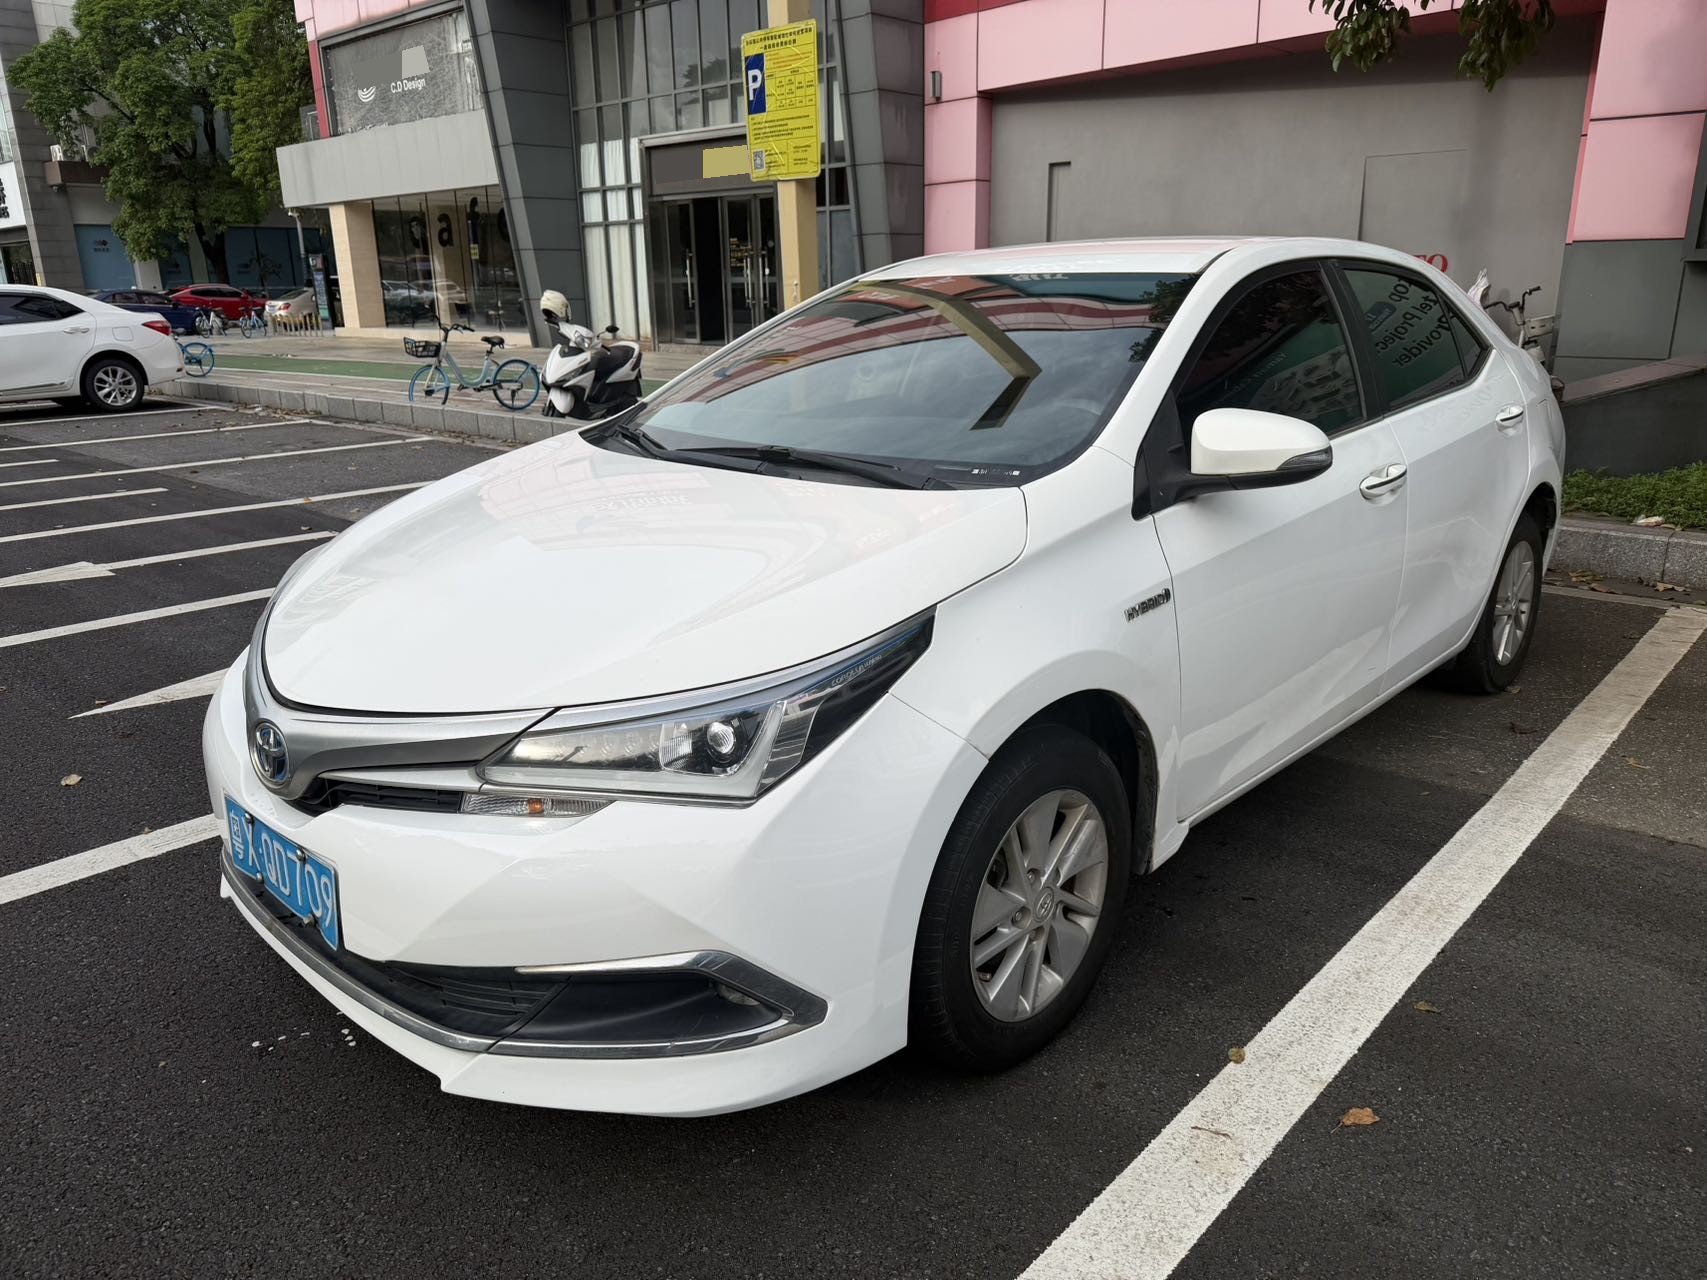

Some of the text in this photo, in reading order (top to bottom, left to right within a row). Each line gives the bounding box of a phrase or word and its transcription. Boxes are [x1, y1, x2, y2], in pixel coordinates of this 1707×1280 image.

[391, 78, 426, 93] C.D Design
[747, 69, 762, 101] P
[1124, 588, 1171, 623] HYBRID
